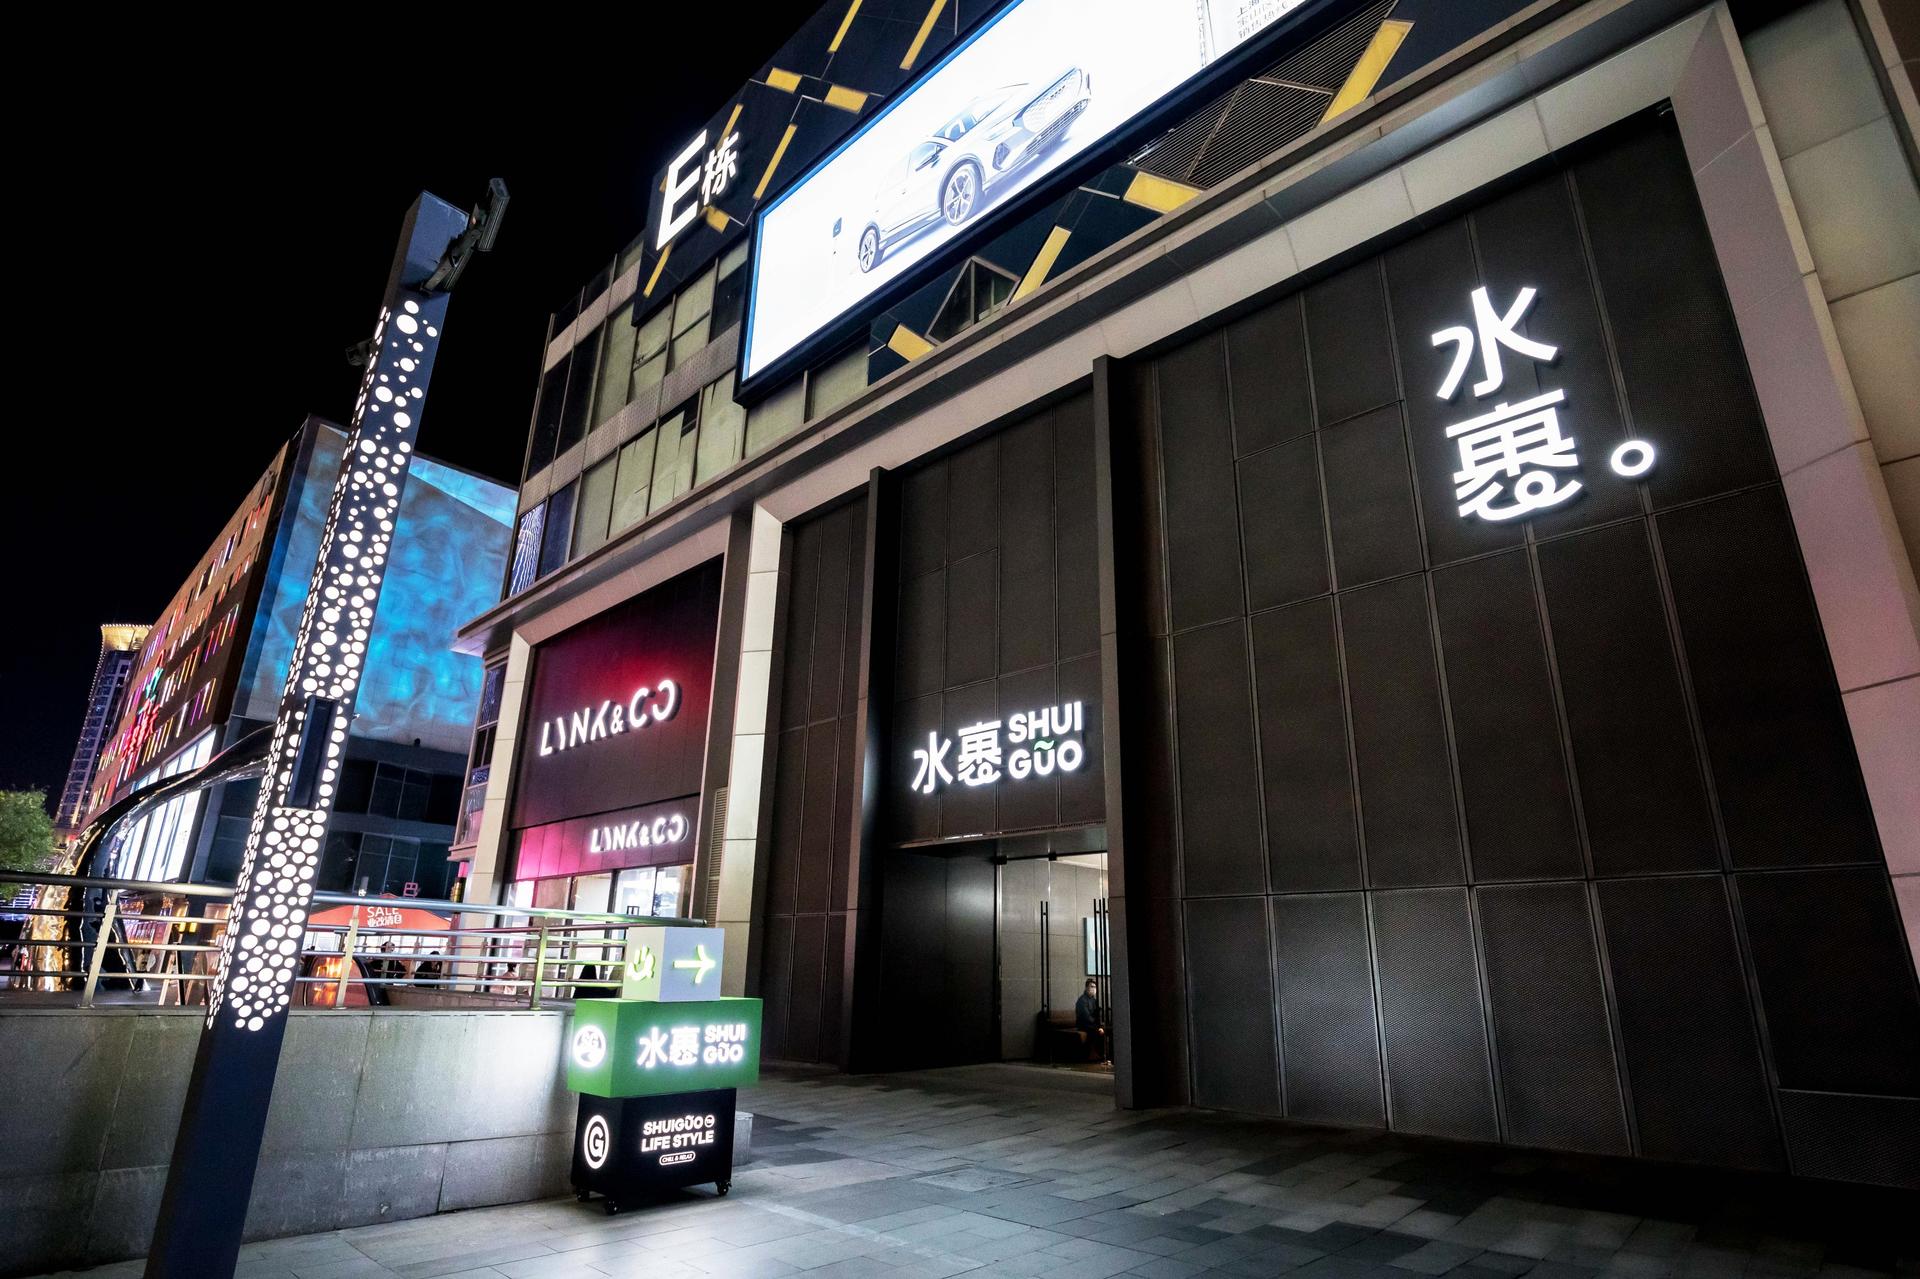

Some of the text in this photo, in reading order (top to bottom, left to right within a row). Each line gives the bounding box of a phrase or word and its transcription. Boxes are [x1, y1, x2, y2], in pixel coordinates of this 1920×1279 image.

[1008, 701, 1082, 743] SHUI
[367, 906, 399, 918] SALE
[704, 1024, 746, 1043] SHUI
[641, 1131, 714, 1152] LIFE STYLE
